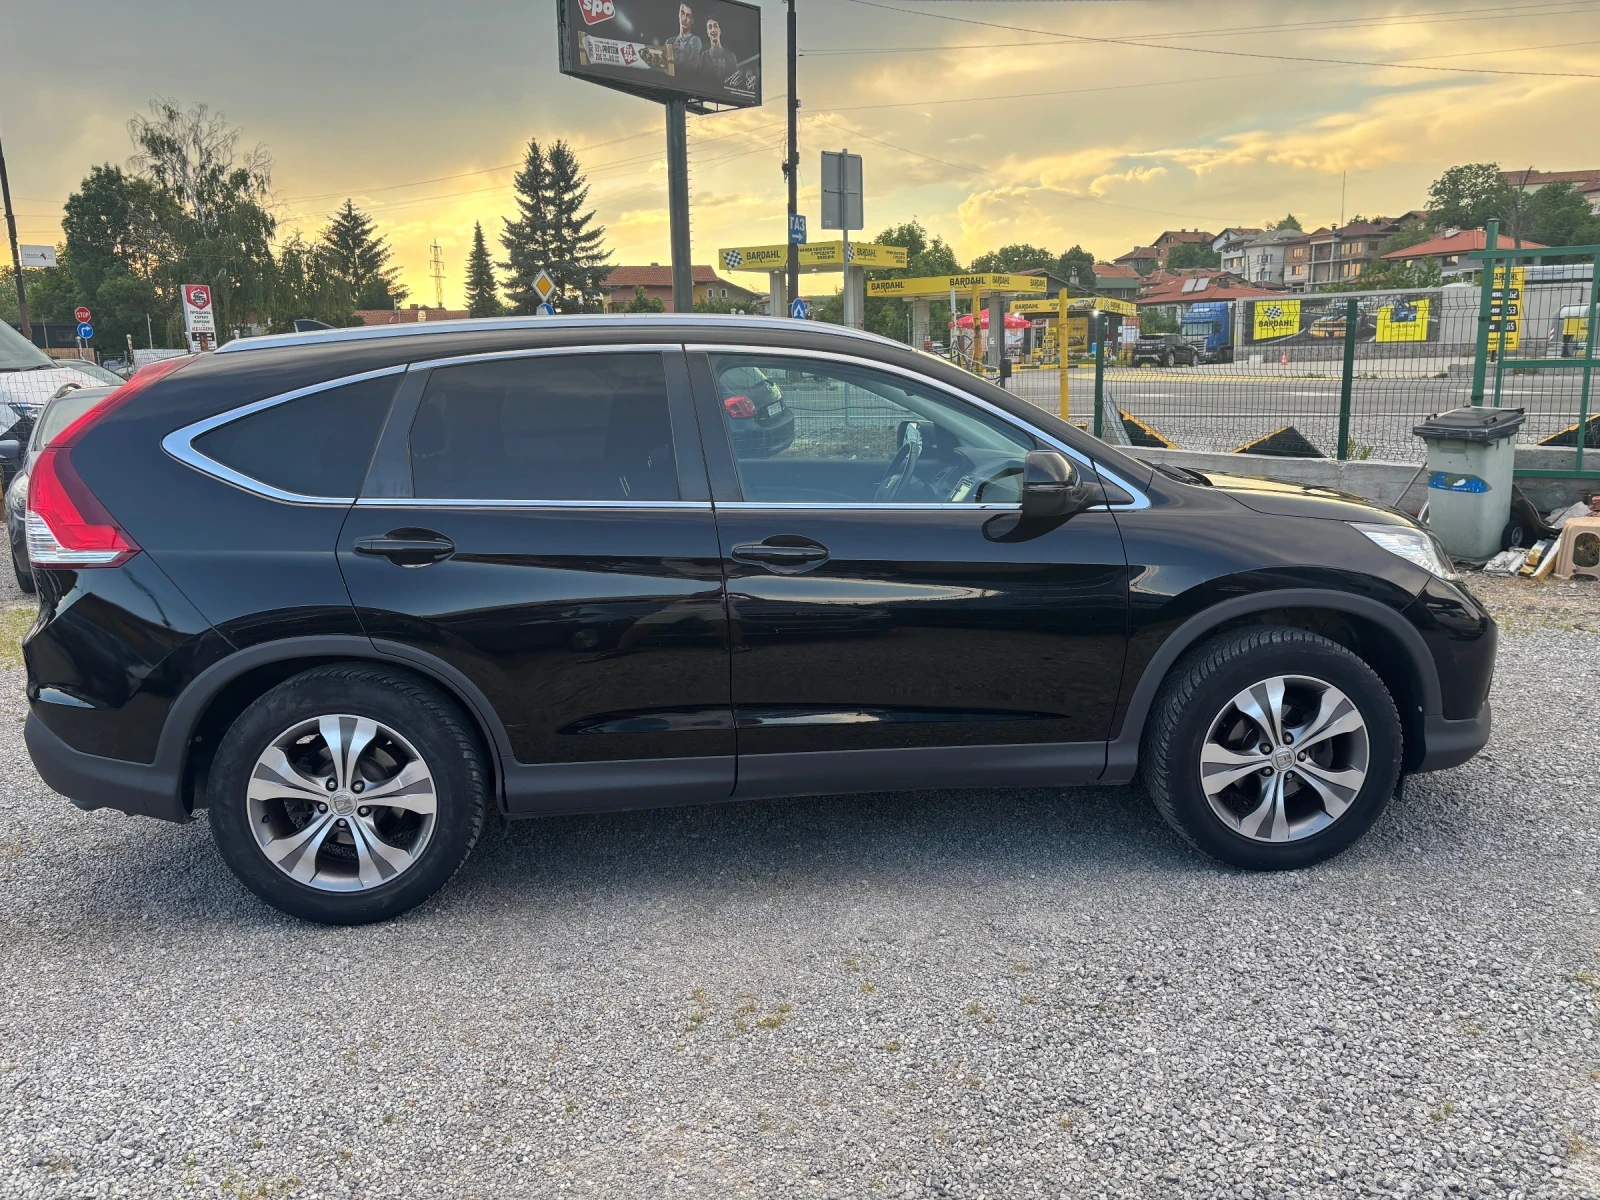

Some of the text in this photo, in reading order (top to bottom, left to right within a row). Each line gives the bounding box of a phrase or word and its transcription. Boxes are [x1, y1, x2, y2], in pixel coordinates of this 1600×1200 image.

[790, 216, 805, 232] ГАЗ
[746, 251, 781, 263] BARDAHL
[856, 248, 877, 260] BARDAHL
[950, 277, 986, 288] BARDAHL
[992, 275, 1010, 286] BARDAHL
[1030, 278, 1046, 288] BARDAHL
[871, 281, 904, 292] BARDAHL
[76, 311, 89, 319] STOP
[1258, 319, 1294, 332] BARDAHL
